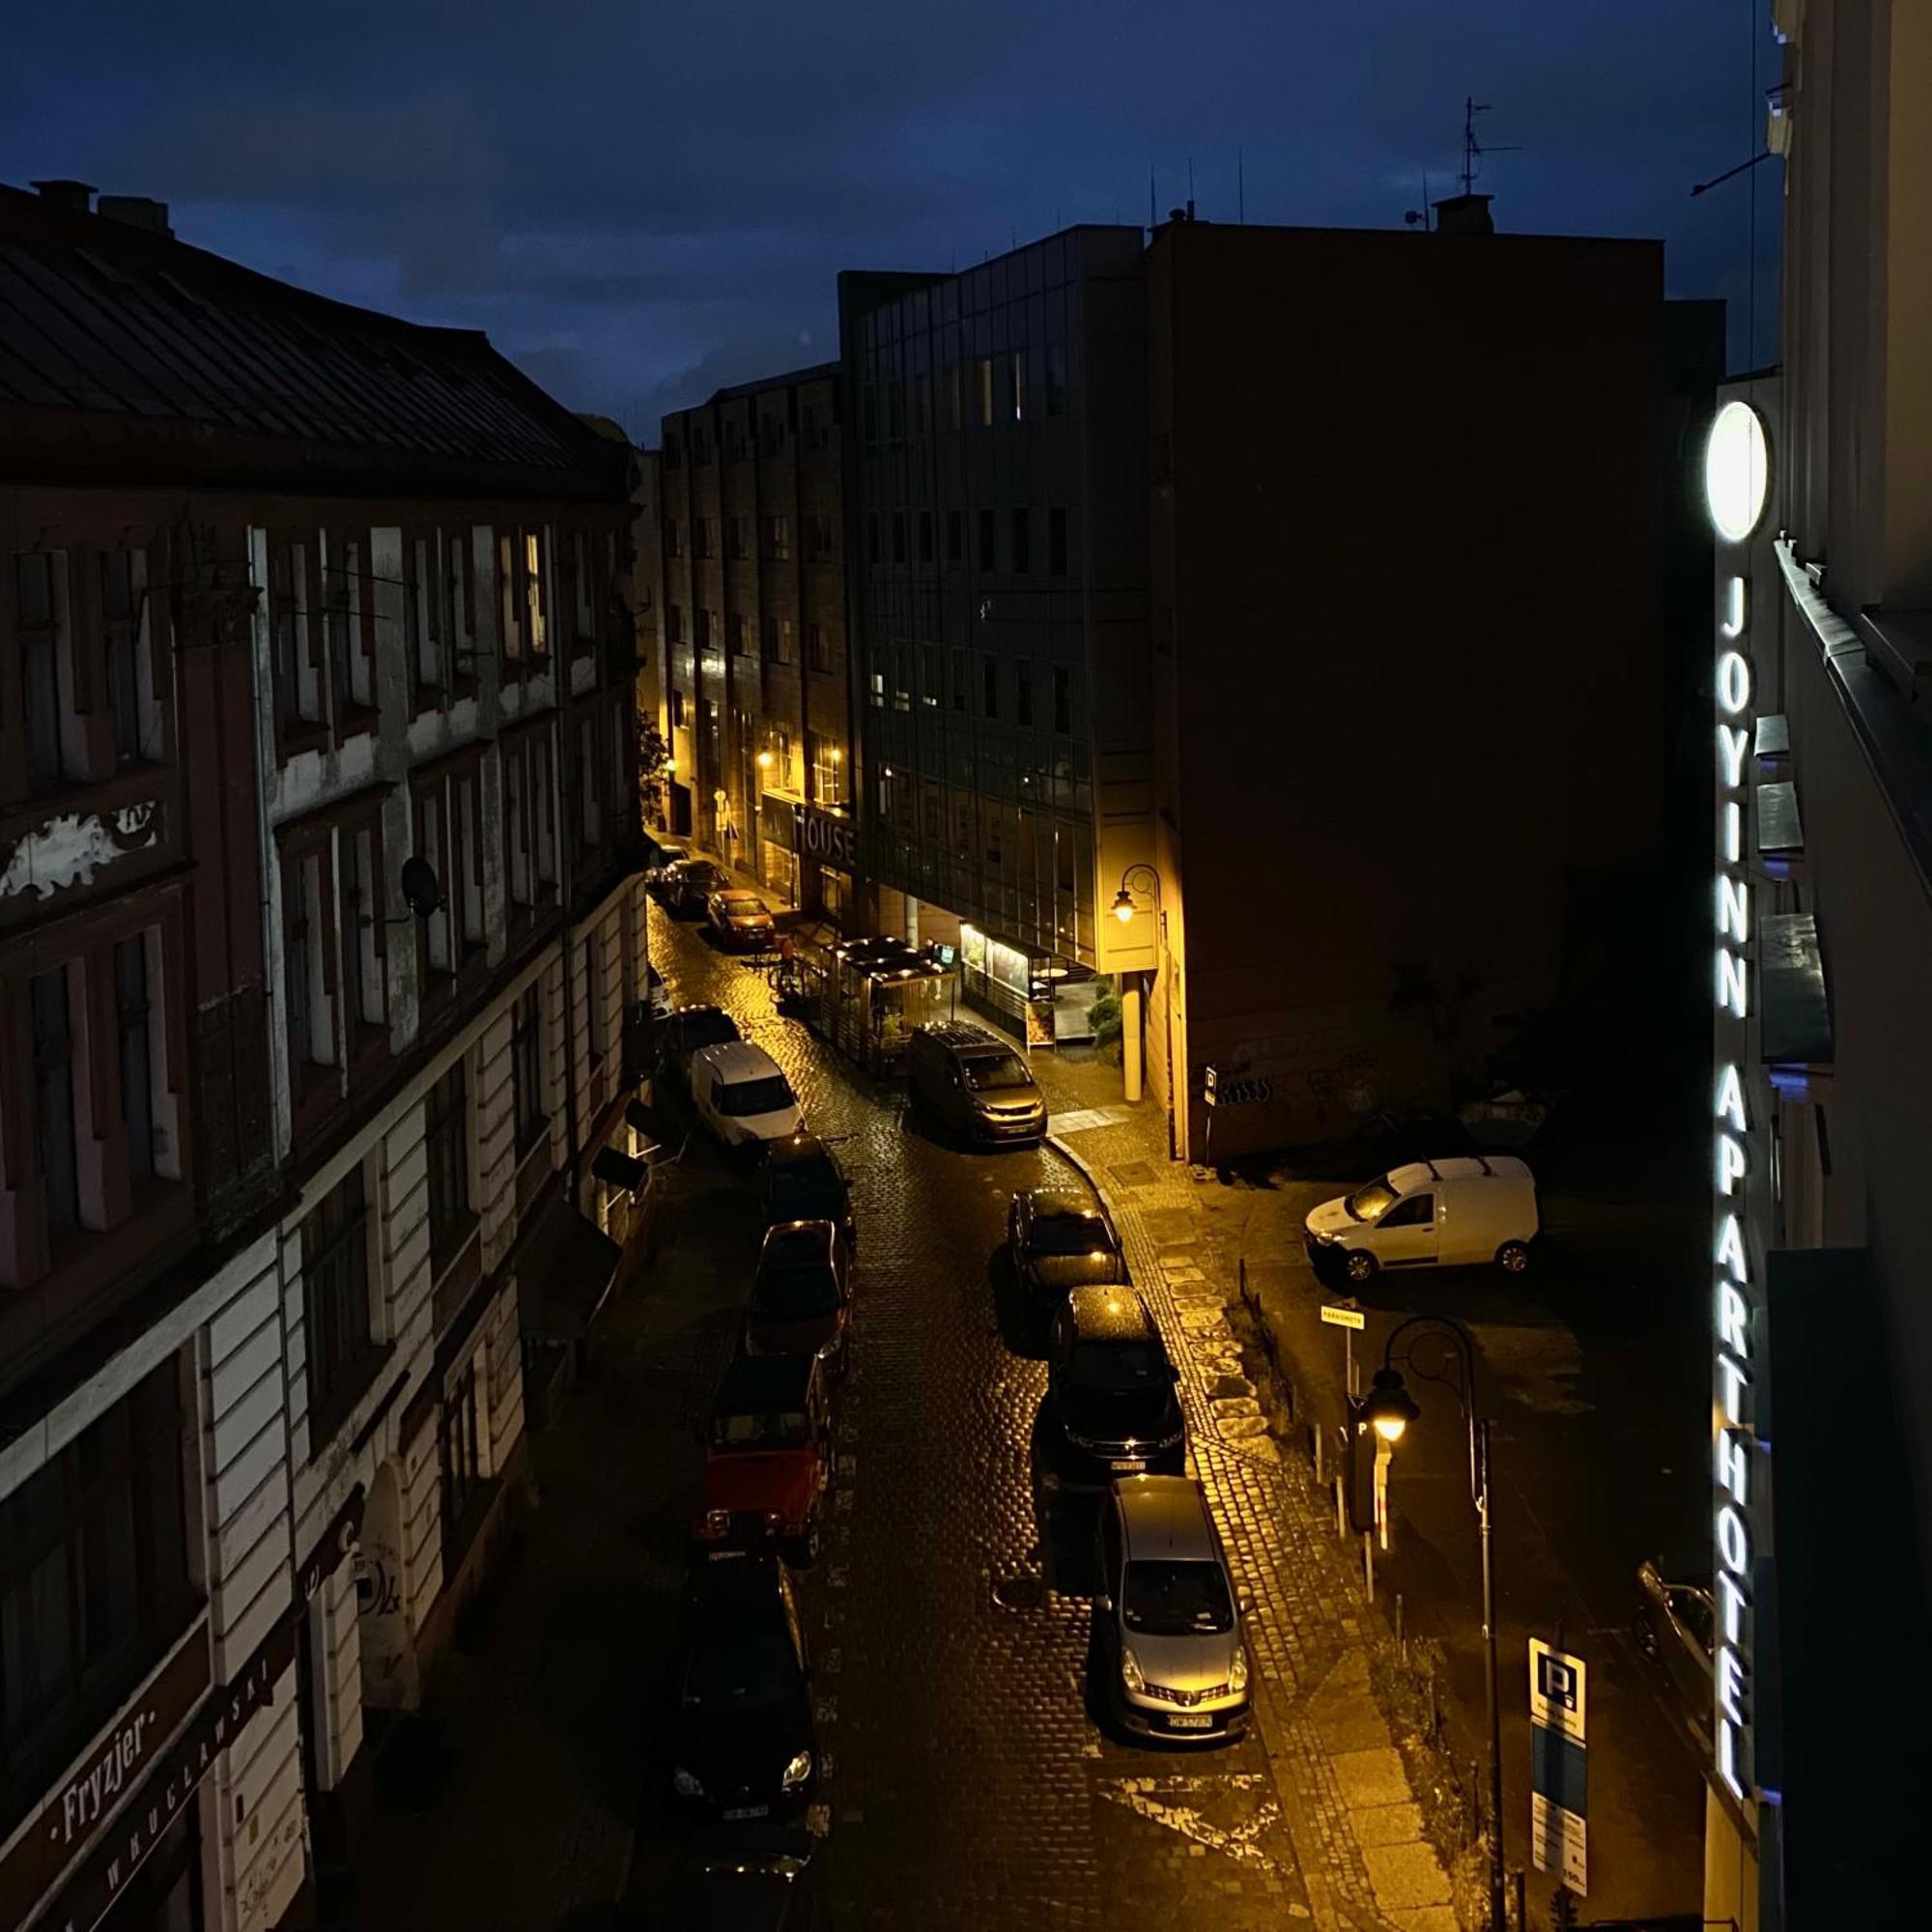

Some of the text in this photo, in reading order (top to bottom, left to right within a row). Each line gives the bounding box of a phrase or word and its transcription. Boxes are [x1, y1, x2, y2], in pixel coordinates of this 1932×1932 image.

[791, 804, 857, 866] HOUSE
[1358, 1422, 1368, 1436] P
[1717, 1063, 1747, 1800] APARTHOTEL
[1546, 1659, 1570, 1696] P
